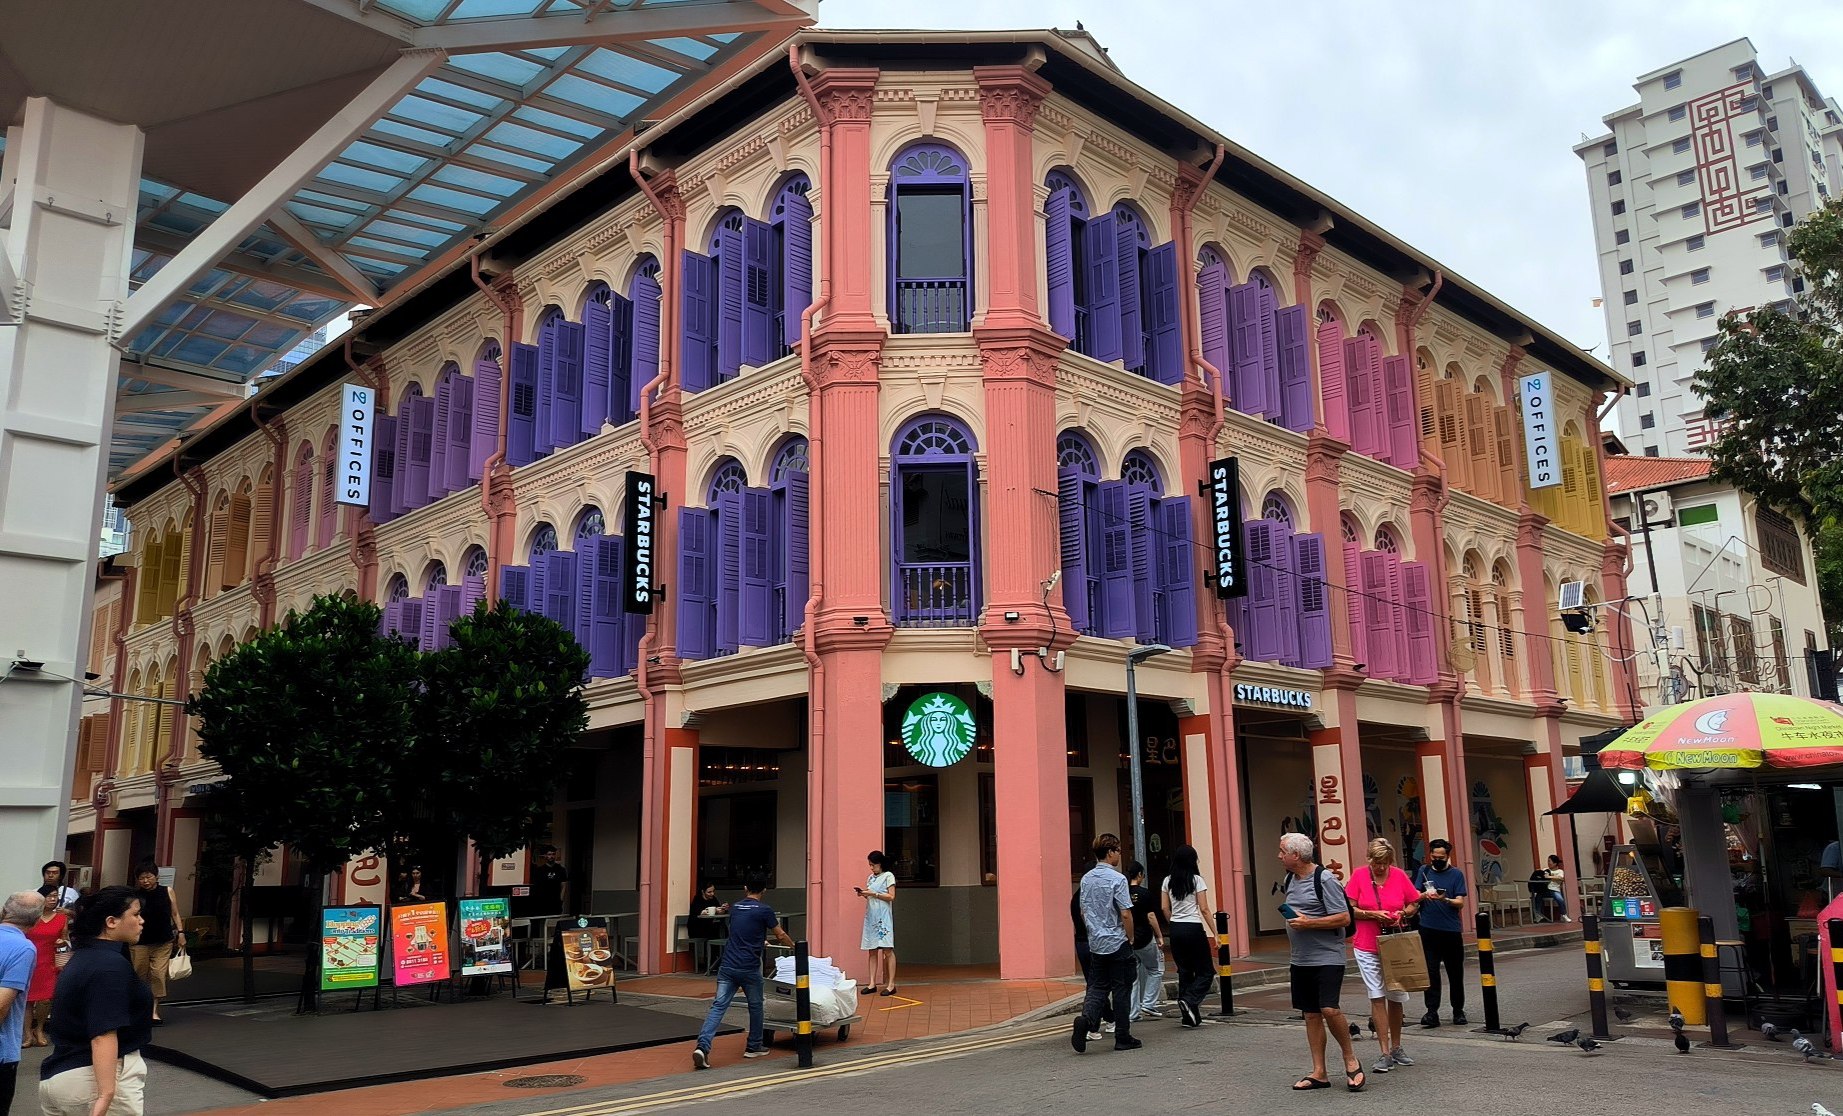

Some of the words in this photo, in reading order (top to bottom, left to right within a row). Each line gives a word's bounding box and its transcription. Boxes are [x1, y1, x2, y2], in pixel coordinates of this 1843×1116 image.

[347, 409, 364, 499] OFFICES
[1530, 396, 1550, 482] OFFICES
[635, 481, 651, 602] STARBUCKS
[1213, 467, 1234, 588] STARBUCKS
[1236, 683, 1312, 708] STARBUCKS
